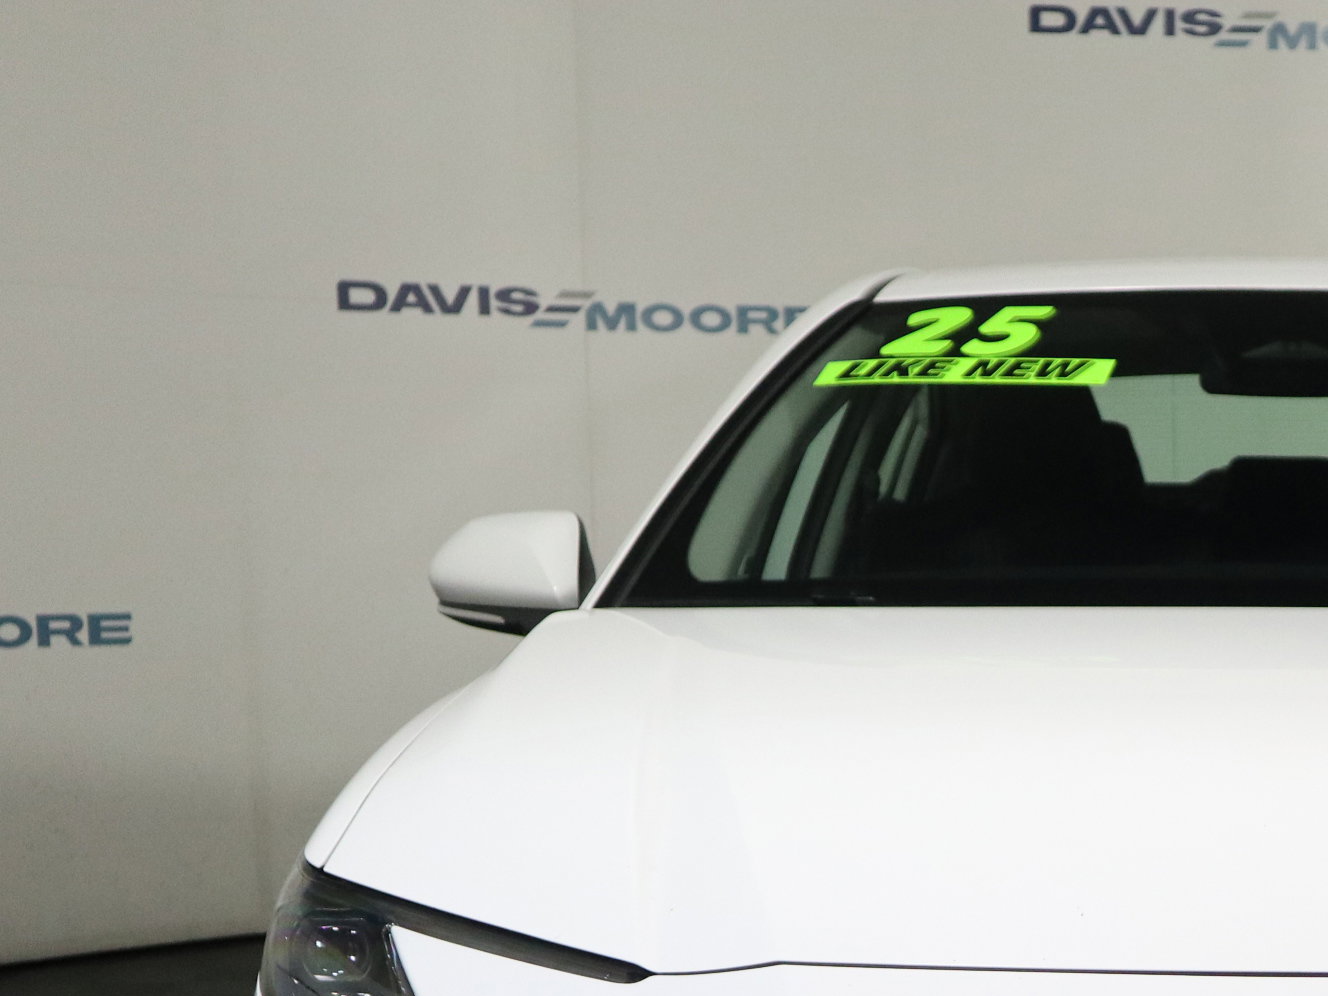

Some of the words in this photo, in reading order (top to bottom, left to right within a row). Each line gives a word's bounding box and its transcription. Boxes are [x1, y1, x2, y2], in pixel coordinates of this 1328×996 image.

[1028, 3, 1224, 39] DAVIS
[336, 278, 541, 318] DAVIS
[880, 305, 1058, 358] 25
[835, 358, 957, 381] LIKE
[962, 358, 1094, 381] NEW
